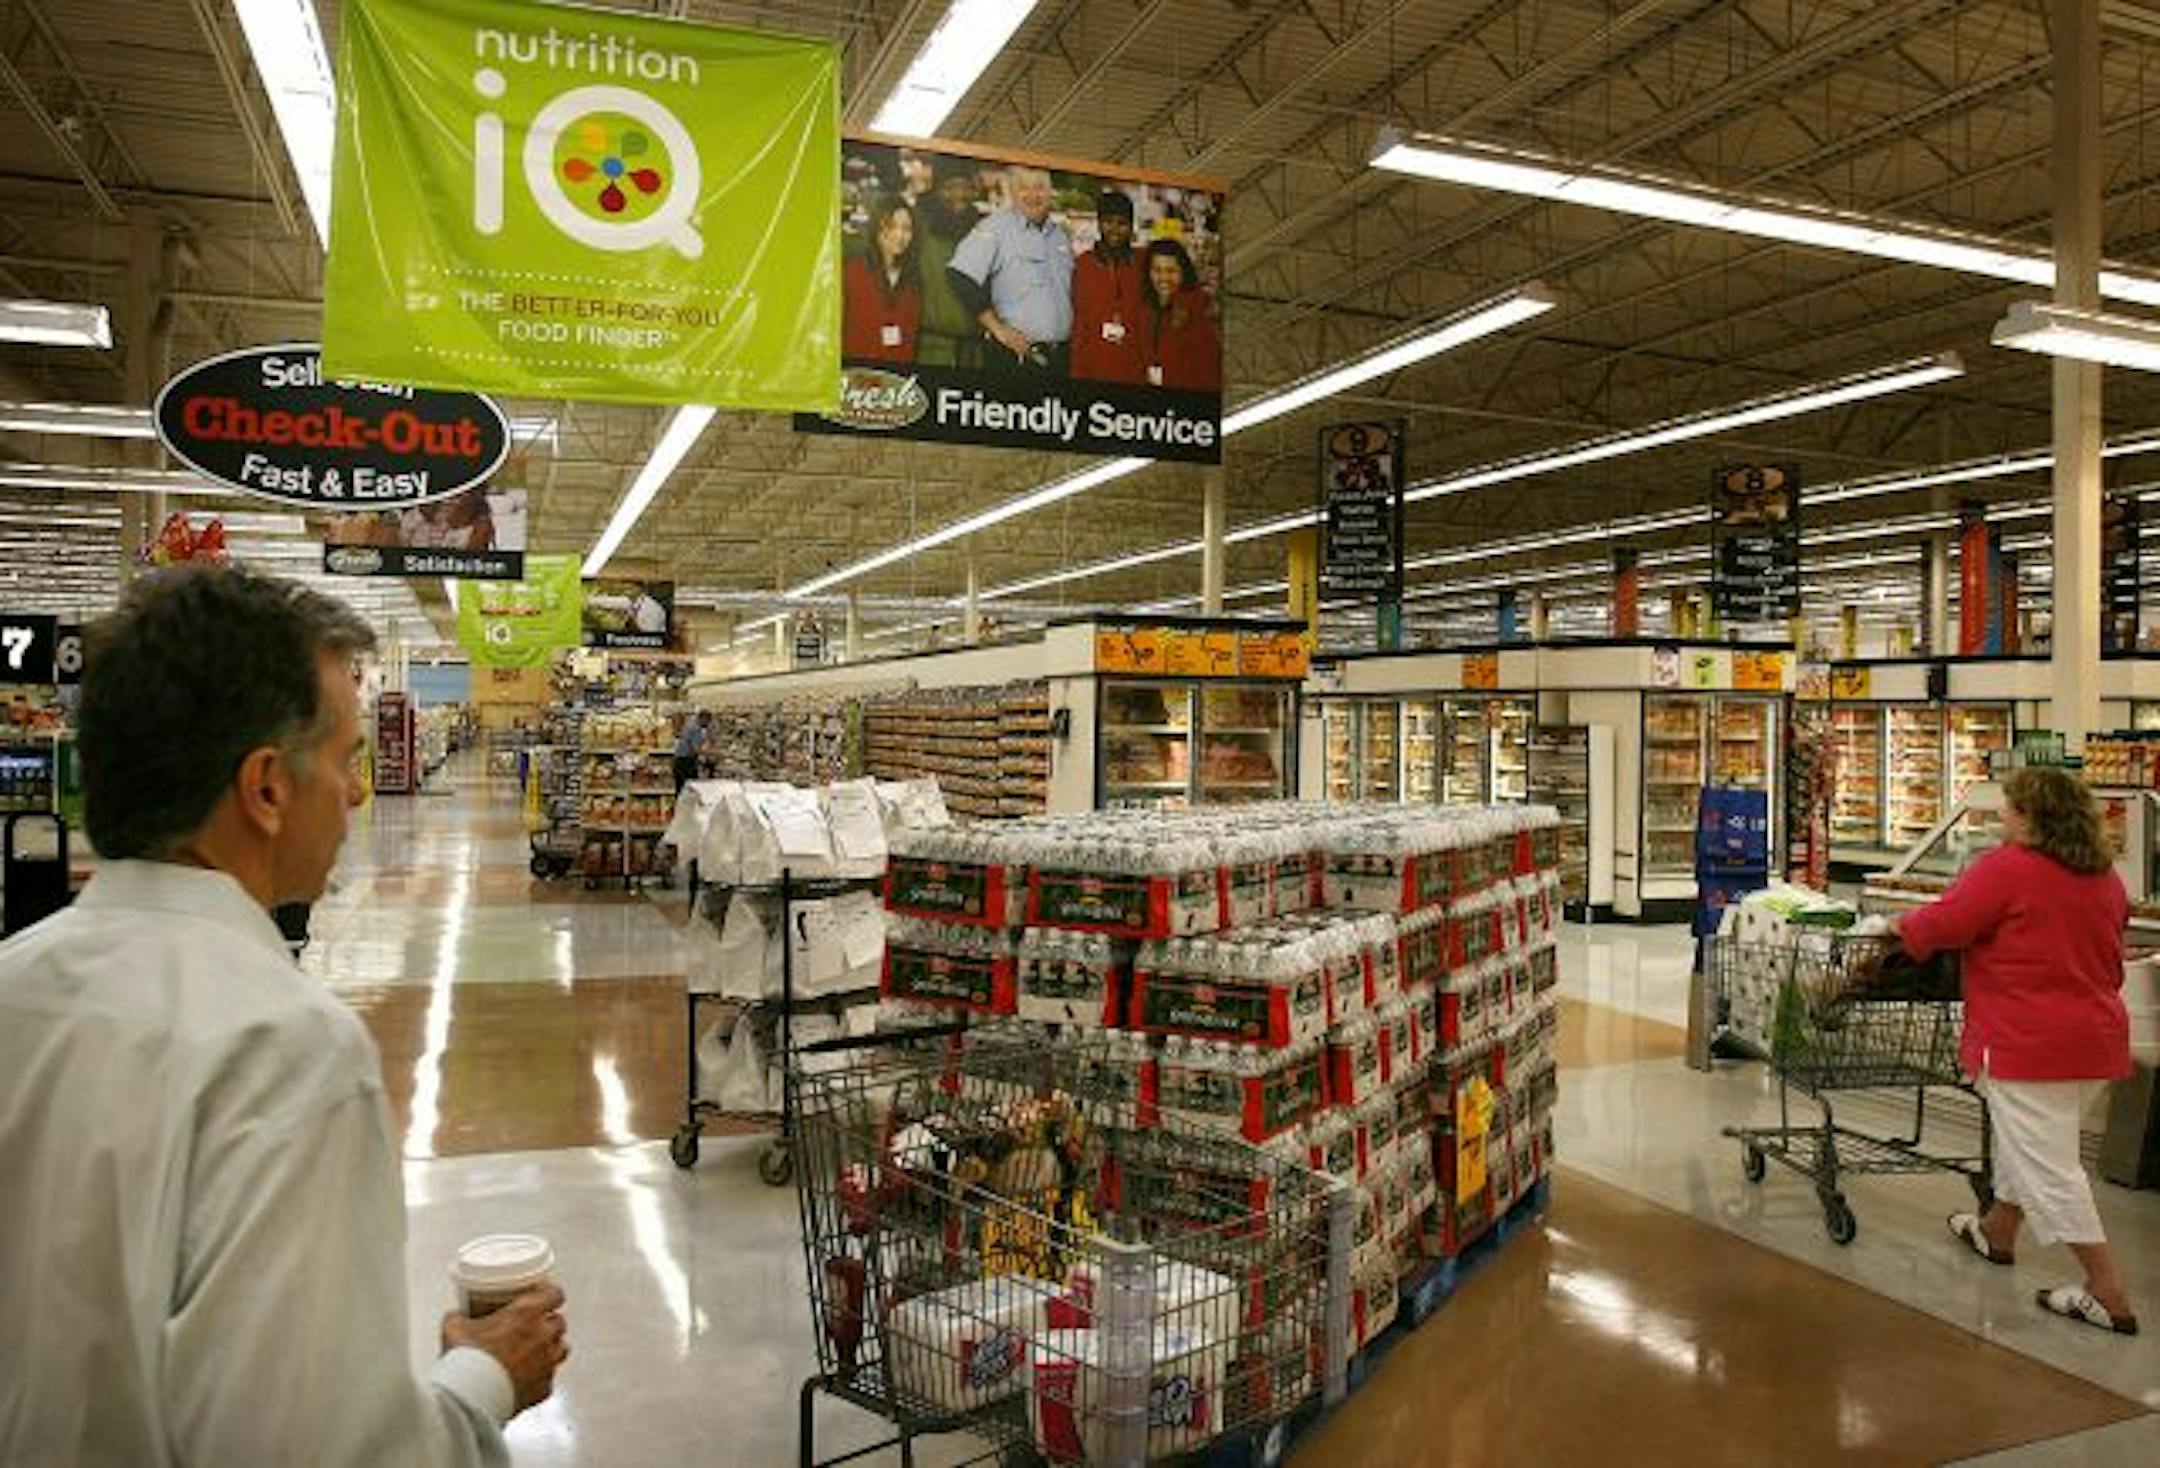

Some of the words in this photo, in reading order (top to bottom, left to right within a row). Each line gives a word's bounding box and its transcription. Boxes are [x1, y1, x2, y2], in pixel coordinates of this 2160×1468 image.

[476, 27, 699, 85] nutrition
[473, 67, 704, 260] iQ
[459, 292, 504, 312] THE
[511, 294, 721, 328] BETTER-FOR-YOU
[500, 320, 569, 343] FOOD
[182, 393, 482, 459] Check-Out
[936, 390, 1081, 440] Friendly
[1089, 402, 1215, 446] Service
[240, 453, 314, 496] Fast
[320, 474, 345, 499] &
[352, 467, 429, 499] Easy
[2, 626, 35, 669] 7
[58, 636, 83, 673] 6
